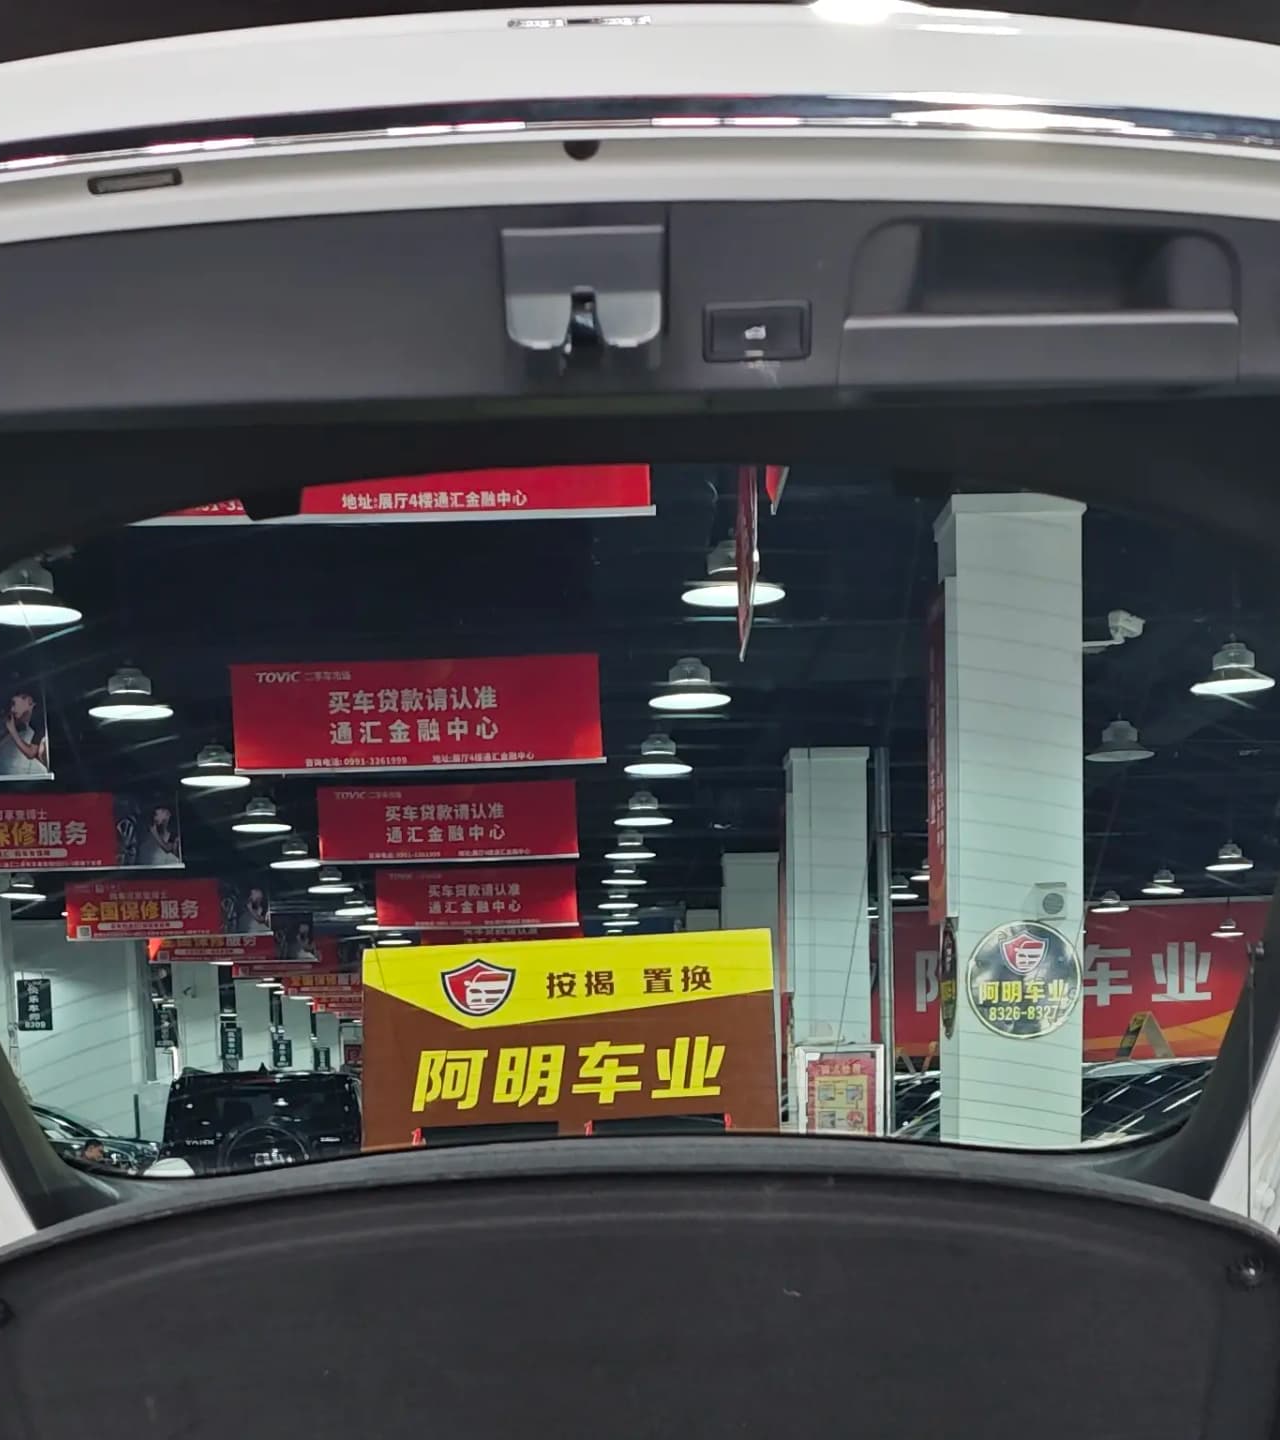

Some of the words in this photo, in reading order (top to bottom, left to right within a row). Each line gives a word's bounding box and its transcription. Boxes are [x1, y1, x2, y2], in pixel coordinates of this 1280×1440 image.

[328, 686, 498, 715] 买车贷款请认准
[329, 716, 499, 745] 通汇金融中心
[385, 803, 505, 822] 买车贷款请认准
[386, 824, 506, 844] 通汇金融中心
[80, 899, 199, 922] 全国保修服务
[546, 970, 614, 999] 按揭
[642, 966, 713, 993] 置换
[979, 979, 1070, 1005] 阿明车业
[988, 1005, 1060, 1022] 8326-8327
[412, 1035, 726, 1113] 阿明车业
